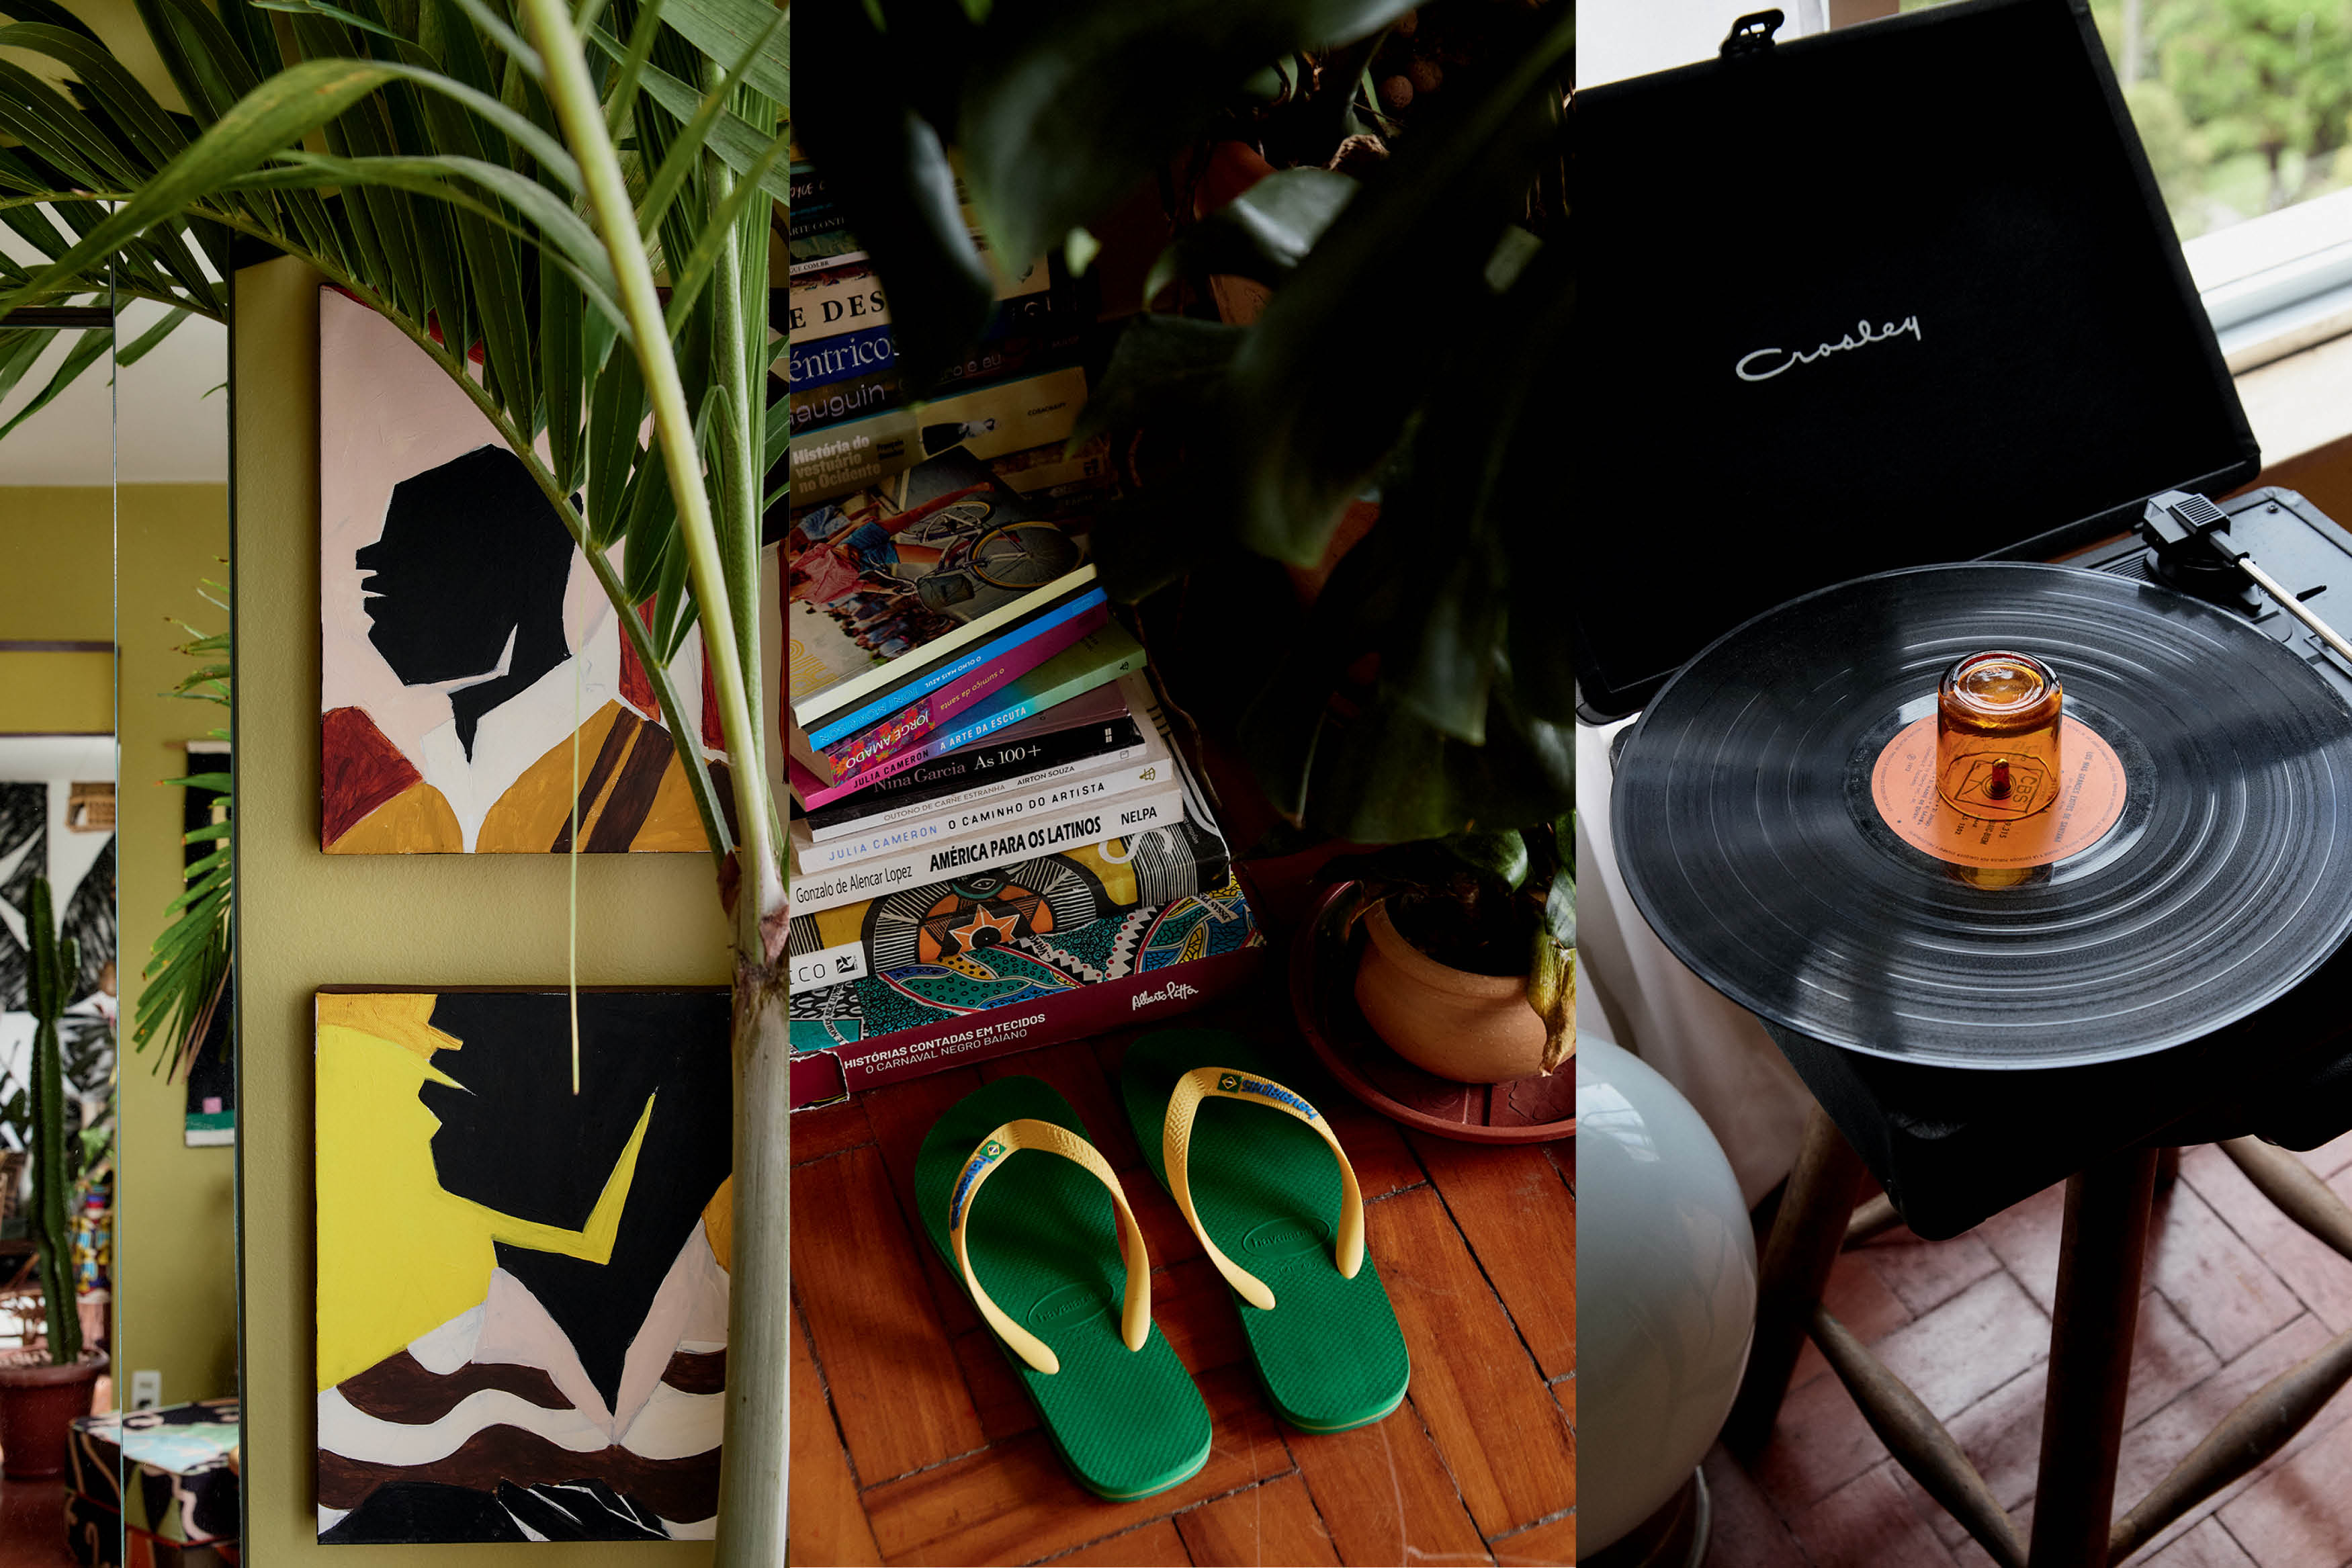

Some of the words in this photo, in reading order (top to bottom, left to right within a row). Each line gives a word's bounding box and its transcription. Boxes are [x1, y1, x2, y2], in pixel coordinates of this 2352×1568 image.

[1735, 314, 1922, 382] Crosley
[789, 383, 885, 425] auguin
[793, 440, 850, 465] História
[852, 435, 869, 450] do
[795, 453, 862, 479] vestuário
[800, 480, 816, 494] no
[819, 464, 881, 488] Ocidente
[942, 669, 957, 680] MAIS
[958, 659, 975, 670] OLHO
[926, 677, 941, 688] AZUL
[961, 689, 971, 699] da
[972, 672, 998, 691] sumiço
[940, 695, 961, 711] santa
[895, 711, 928, 741] JORGE
[846, 737, 891, 769] AMADO
[853, 769, 881, 789] JULIA
[883, 749, 930, 775] CAMERON
[941, 742, 947, 751] A
[949, 730, 973, 747] ARTE
[975, 724, 988, 736] DA
[991, 706, 1027, 729] ESCUTA
[873, 775, 913, 793] Nina
[914, 761, 967, 783] Garcia
[973, 755, 995, 771] As
[2013, 775, 2037, 803] CBS
[883, 803, 921, 822] OUTONO
[922, 801, 934, 812] DE
[936, 795, 963, 808] CARNE
[964, 784, 1006, 801] ESTRANHA
[1016, 773, 1047, 786] AIRTON
[1048, 766, 1075, 777] SOUZA
[828, 843, 867, 861] JULIA
[873, 825, 938, 850] CAMERON
[948, 820, 957, 830] O
[962, 802, 1023, 827] CAMINHO
[1029, 797, 1045, 809] DO
[1051, 782, 1105, 803] ARTISTA
[795, 881, 834, 903] Gonzalo
[836, 877, 848, 894] de
[850, 872, 883, 891] Alencar
[884, 866, 913, 885] Lopez
[929, 842, 990, 872] AMÉRICA
[990, 834, 1027, 858] PARA
[1028, 828, 1045, 848] OS
[1047, 816, 1102, 845] LATINOS
[1121, 806, 1158, 826] NELPA
[1132, 990, 1168, 1011] Alberto
[1166, 981, 1199, 1000] Pitta
[844, 1046, 908, 1070] HISTÓRIAS
[909, 1031, 974, 1053] CONTADAS
[976, 1025, 994, 1039] EM
[994, 1013, 1046, 1033] TECIDOS
[865, 1064, 874, 1075] O
[876, 1051, 939, 1072] CARNAVAL
[941, 1039, 982, 1056] NEGRO
[984, 1029, 1027, 1046] BAIANO
[1240, 1078, 1319, 1121] havaianas
